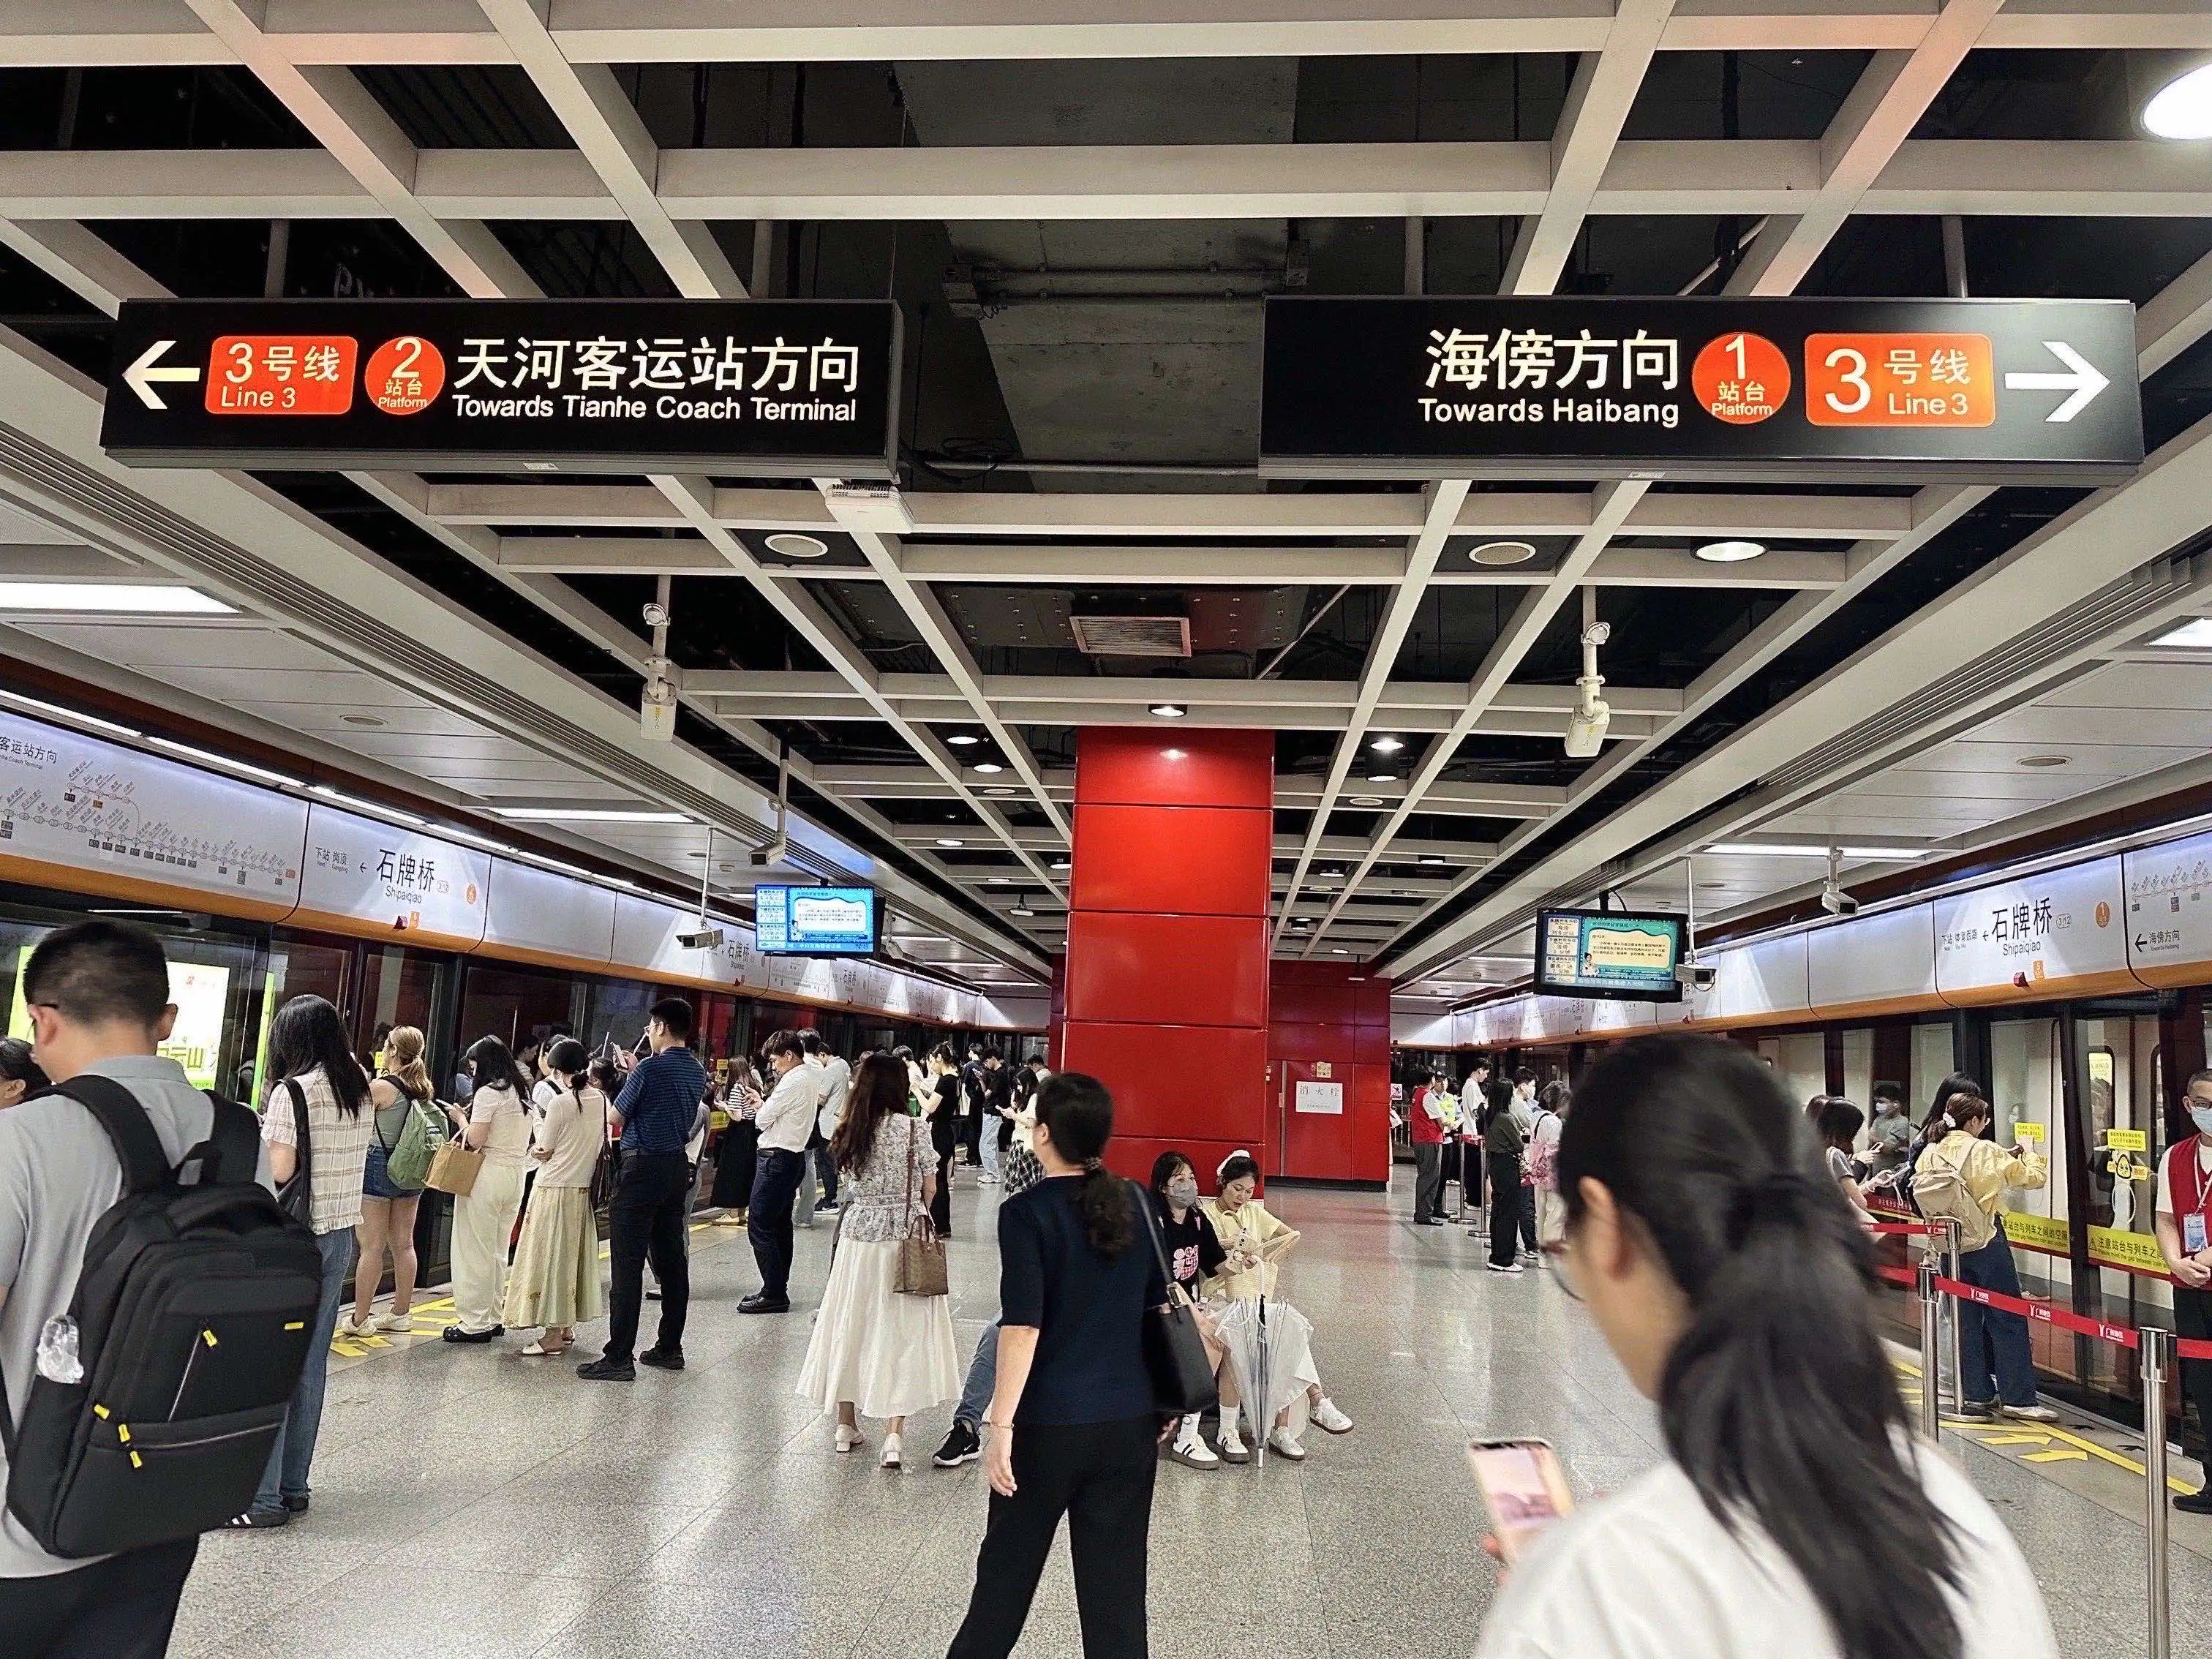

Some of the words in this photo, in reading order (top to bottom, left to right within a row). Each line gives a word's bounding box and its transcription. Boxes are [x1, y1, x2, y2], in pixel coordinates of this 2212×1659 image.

[391, 337, 422, 378] 2
[454, 336, 859, 392] 天河客运站方向
[1425, 328, 1678, 391] 海傍方向
[1725, 334, 1746, 380] 1
[1884, 349, 1971, 385] 号线
[385, 378, 423, 396] 站台
[1718, 381, 1765, 403] 站台
[1824, 348, 1871, 413] 3
[221, 387, 274, 408] Line
[281, 387, 296, 408] 3
[378, 396, 427, 409] Platform
[452, 394, 554, 418] Towards
[563, 395, 647, 418] Tianhe
[656, 396, 741, 420] Coach
[750, 397, 857, 421] Terminal
[1712, 402, 1773, 416] Platform
[1889, 393, 1946, 415] Line
[1951, 394, 1968, 415] 3
[1418, 398, 1544, 424] Towards
[1553, 397, 1679, 429] Haibang
[376, 849, 435, 893] 石牌桥
[385, 884, 422, 904] Shipaiqiao
[1992, 897, 2053, 943] 石牌桥
[2003, 940, 2042, 957] Shipaiqiao
[2097, 1236, 2163, 1259] 注意站台与列车之
